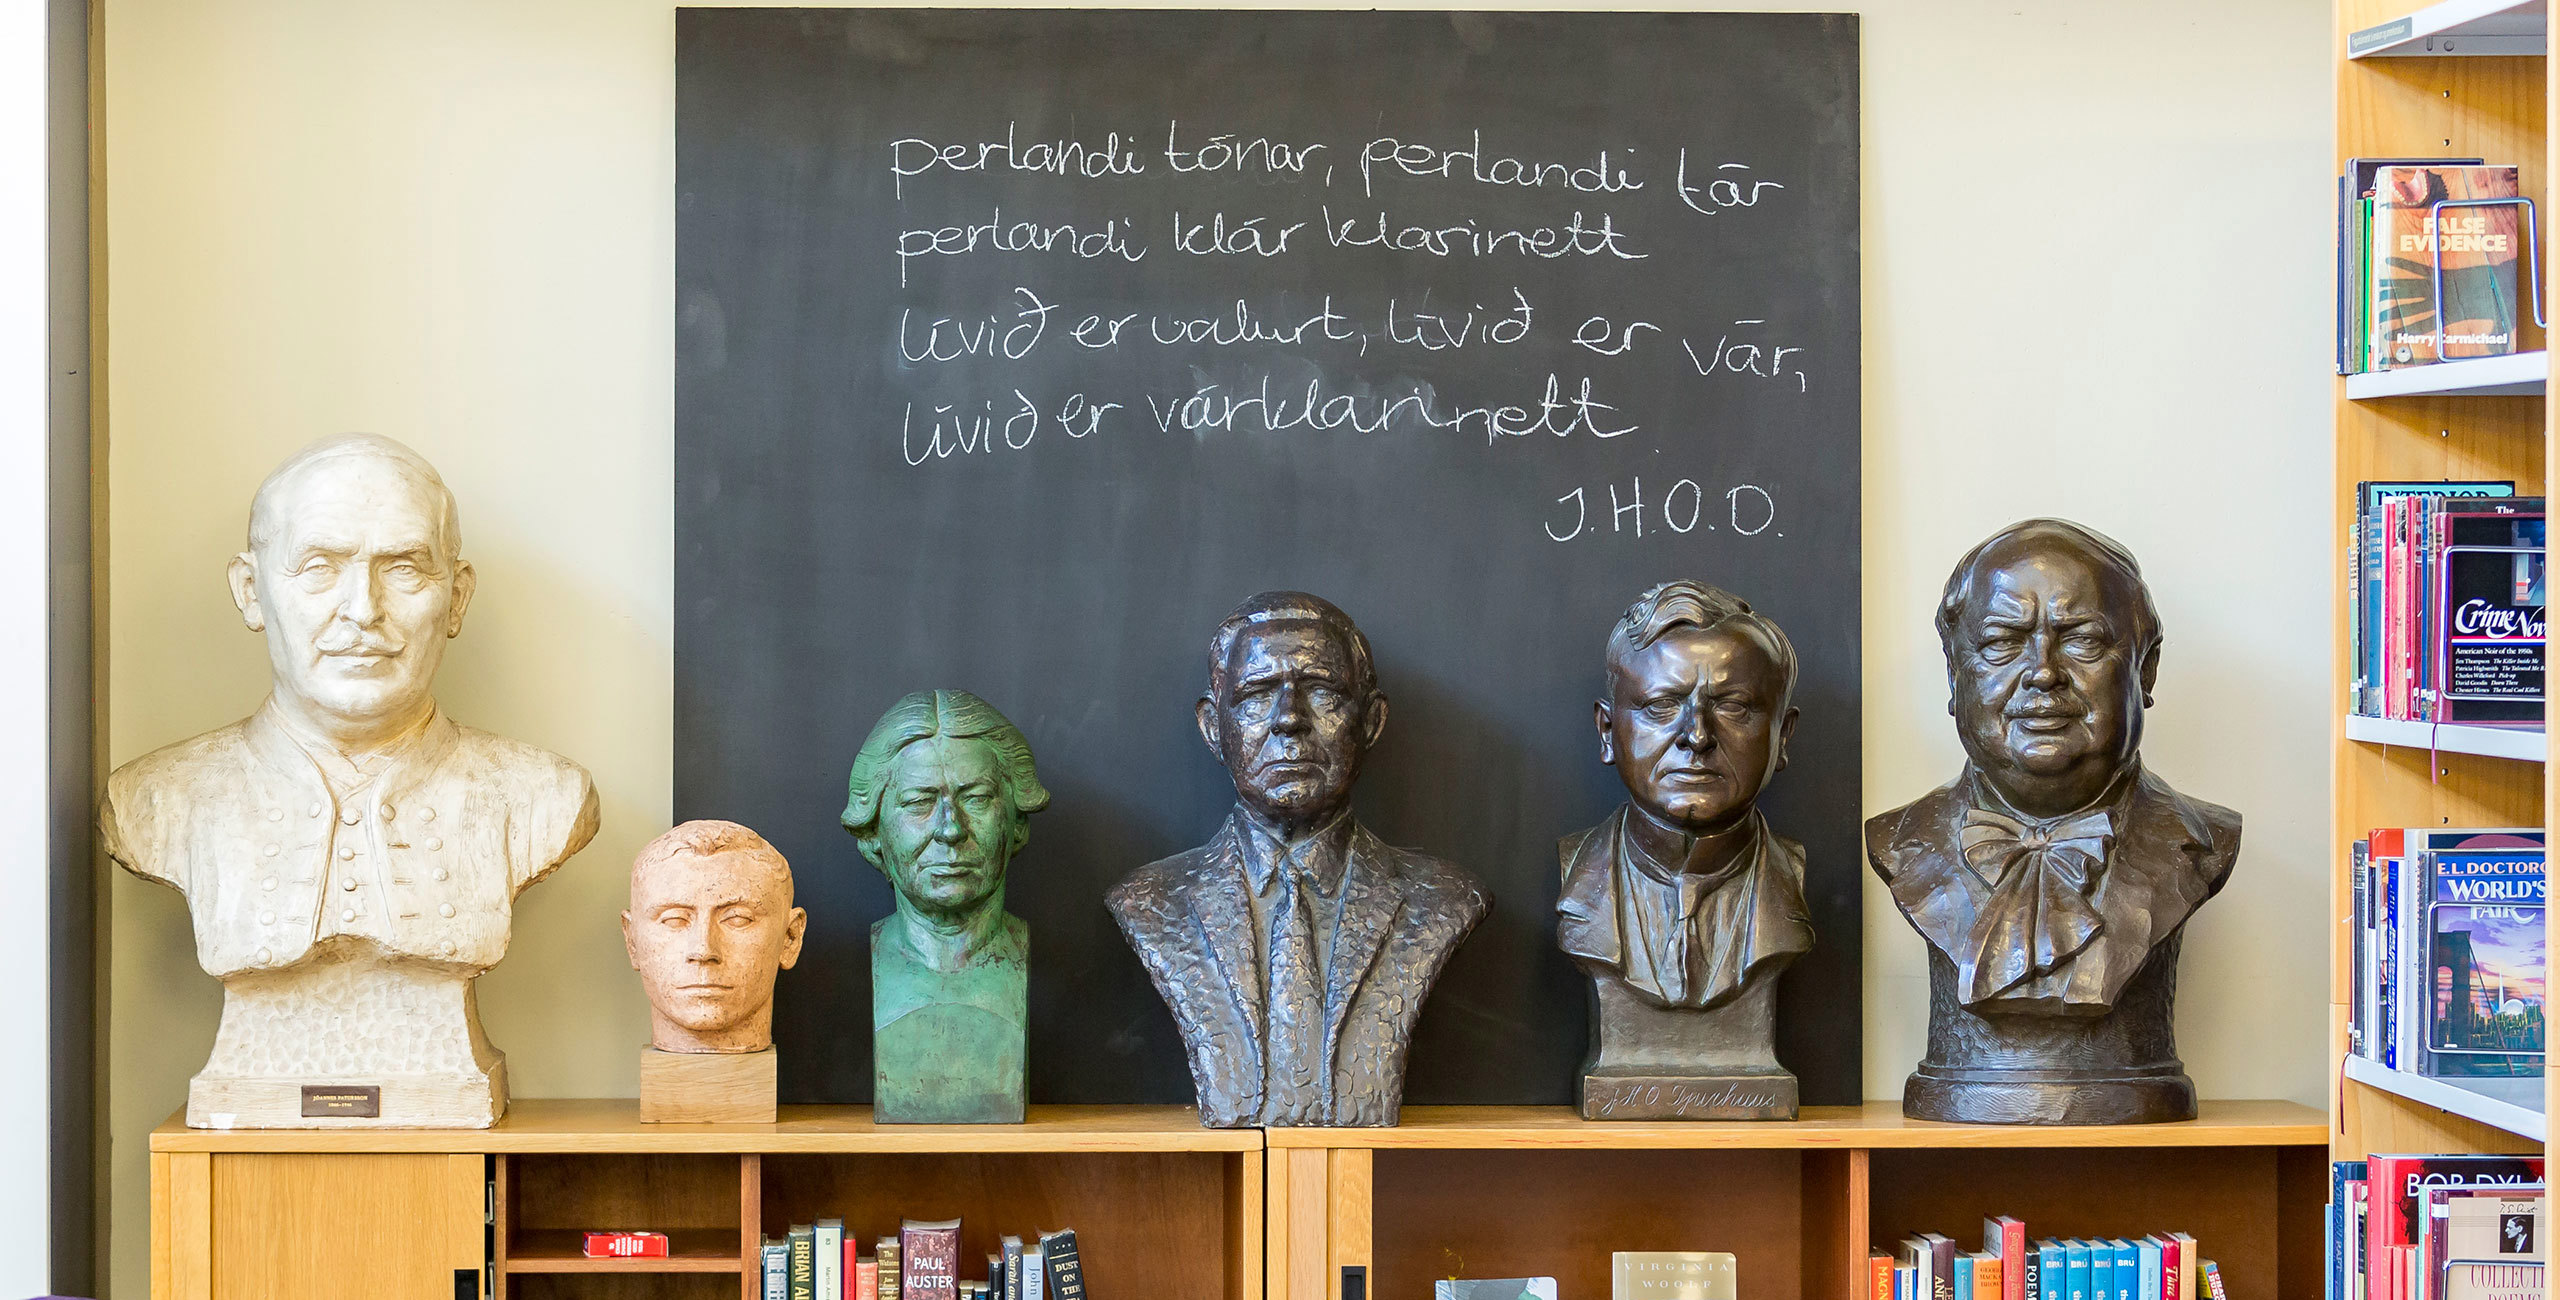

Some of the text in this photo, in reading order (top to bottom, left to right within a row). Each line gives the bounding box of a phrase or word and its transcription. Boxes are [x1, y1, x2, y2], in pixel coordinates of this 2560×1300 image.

[890, 120, 1145, 200] perlandi
[1361, 130, 1644, 198] perlandi
[2423, 217, 2485, 234] FALSE
[896, 206, 1147, 288] perlandi
[2400, 235, 2507, 252] EVIDENCE
[1070, 310, 1139, 348] er
[1572, 316, 1661, 355] er
[2396, 333, 2508, 346] Harry armichael
[1057, 392, 1125, 438] er
[2495, 506, 2514, 515] The
[2455, 598, 2518, 639] Crime
[2447, 879, 2546, 901] WORLD'S
[2470, 899, 2537, 924] FAIR
[794, 1241, 810, 1282] BRIAN
[914, 1258, 945, 1270] PAUL
[1008, 1253, 1020, 1285] Sarah
[1055, 1260, 1079, 1273] DUST
[1624, 1263, 1728, 1272] VIRGINIA
[906, 1276, 954, 1288] AUSTER
[1030, 1268, 1041, 1296] John
[1062, 1273, 1076, 1283] ON
[1642, 1280, 1712, 1289] WOOLF
[2165, 1265, 2178, 1296] Three
[1061, 1284, 1081, 1296] THE
